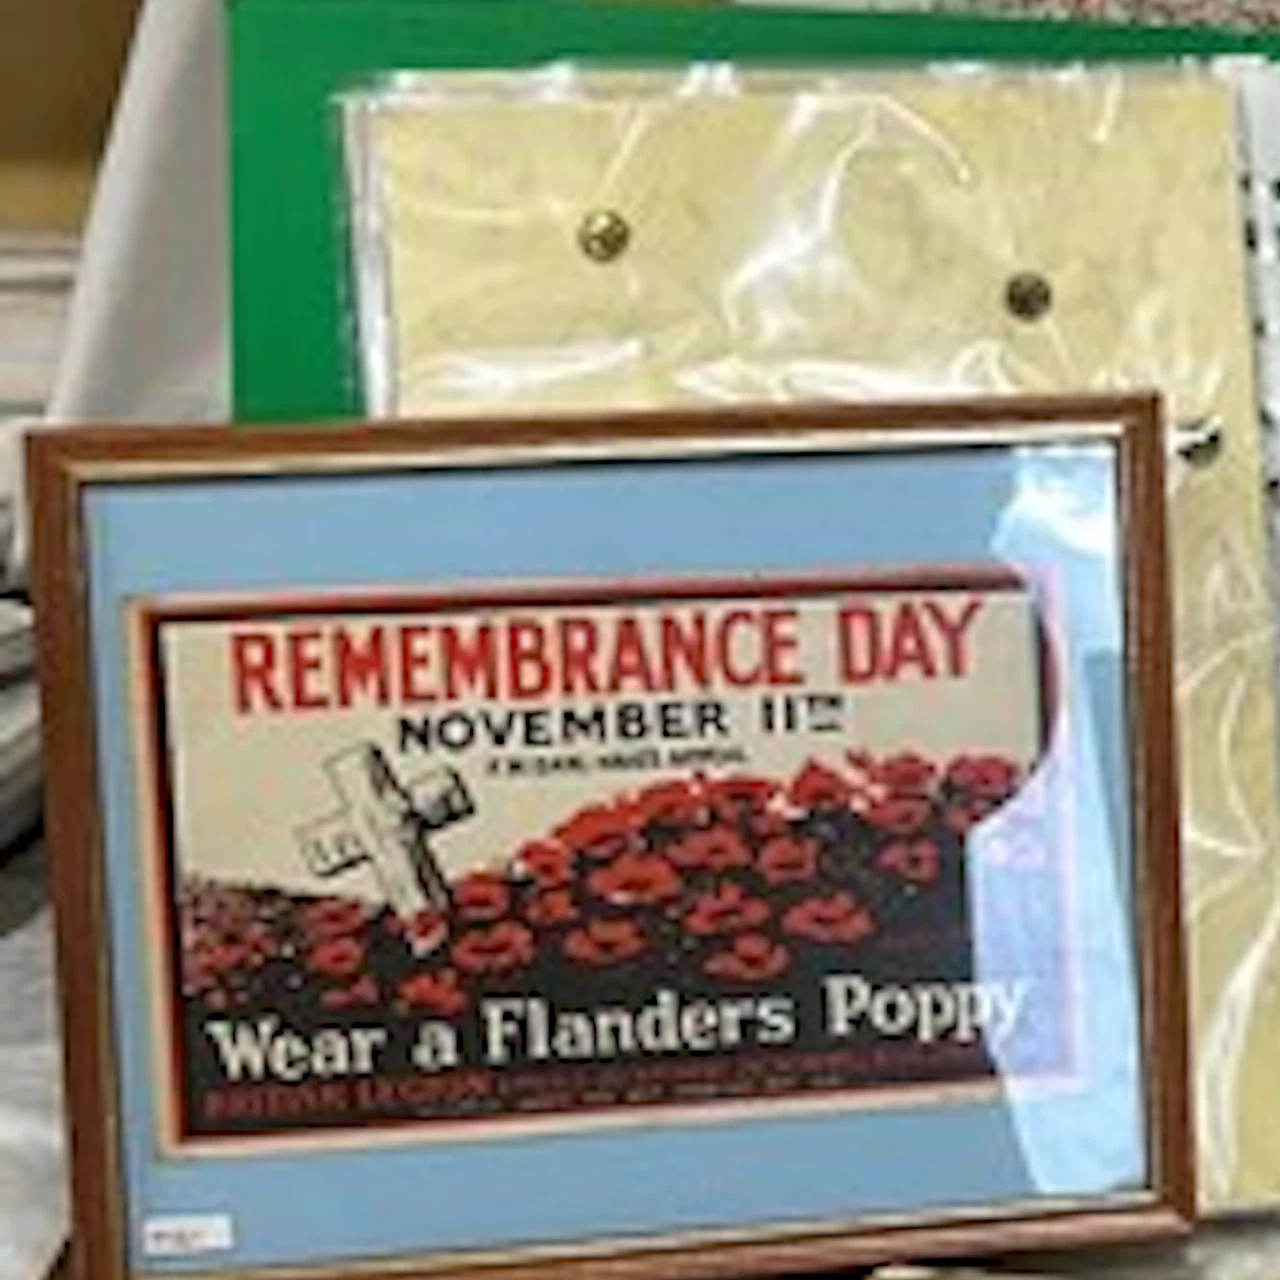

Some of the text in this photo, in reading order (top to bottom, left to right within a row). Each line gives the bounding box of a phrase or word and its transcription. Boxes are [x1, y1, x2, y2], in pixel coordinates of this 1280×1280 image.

[229, 599, 986, 718] REMEMBRANCE DAY
[398, 700, 730, 754] NOVEMBER
[203, 1015, 390, 1083] Wear
[410, 1018, 464, 1072] a
[479, 986, 798, 1068] Flanders
[819, 972, 1029, 1054] Poppy
